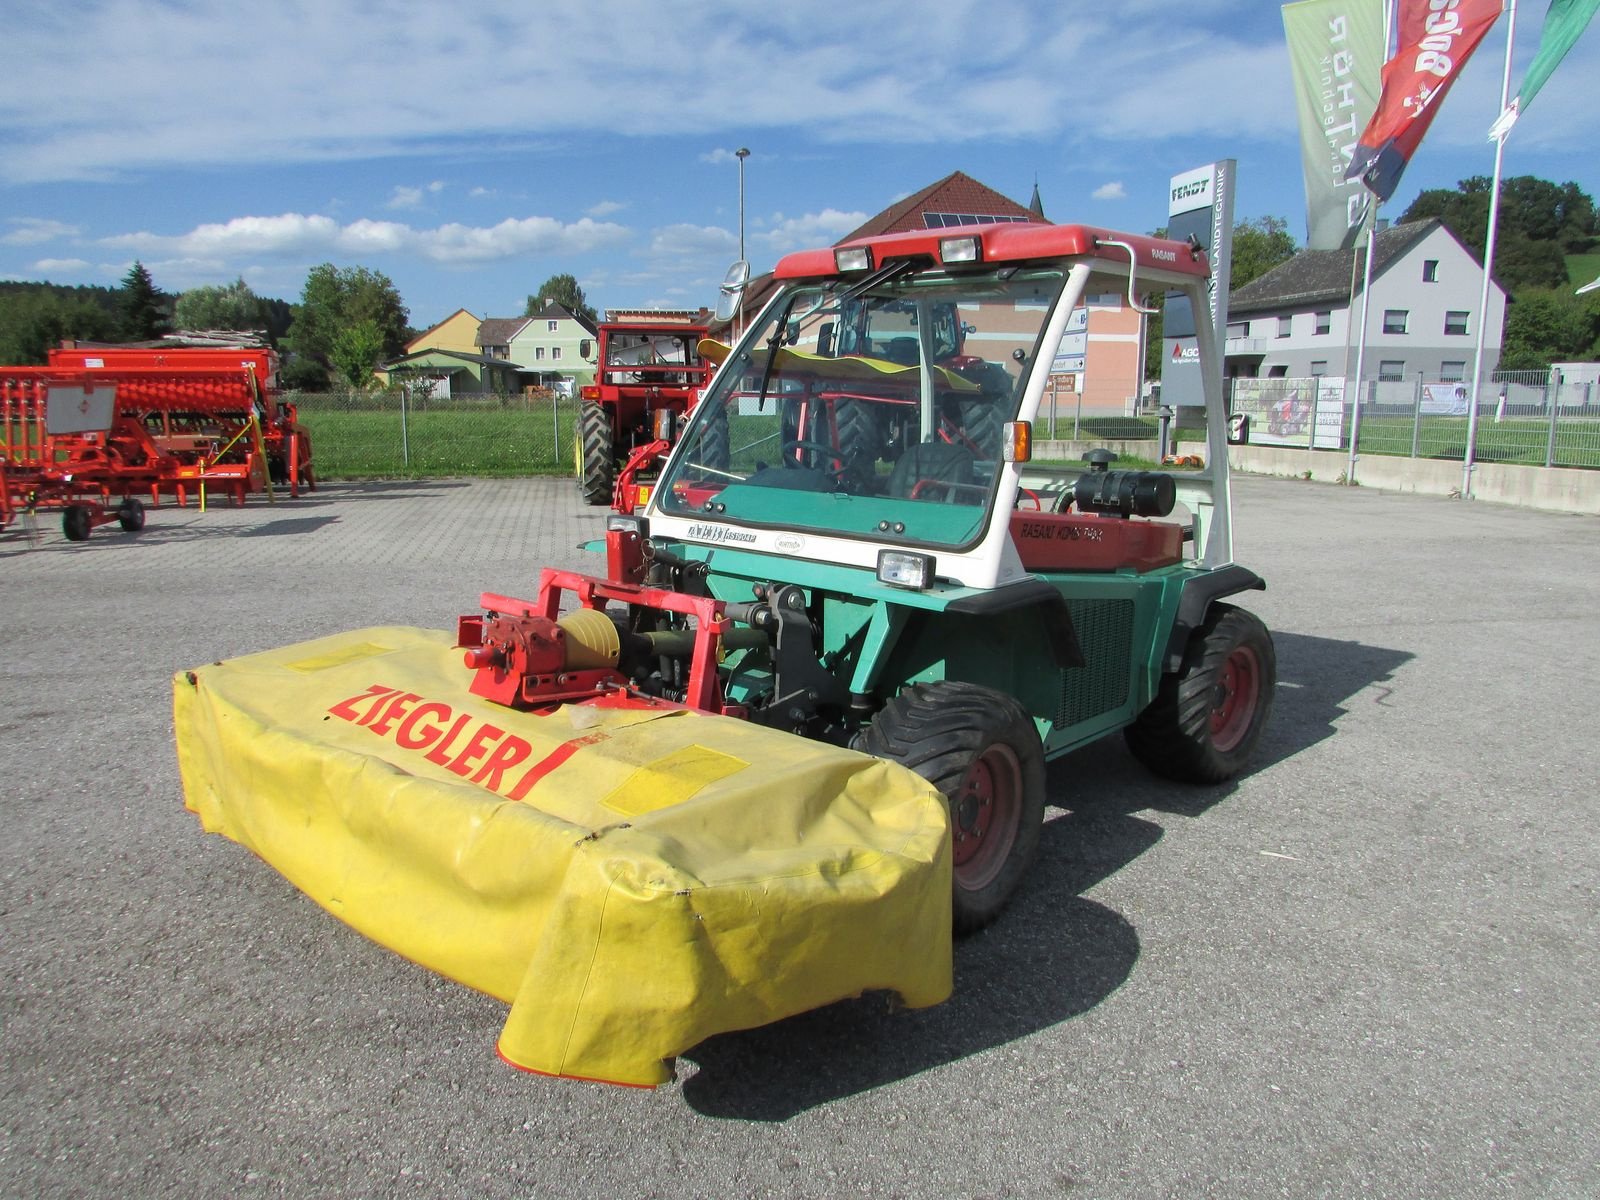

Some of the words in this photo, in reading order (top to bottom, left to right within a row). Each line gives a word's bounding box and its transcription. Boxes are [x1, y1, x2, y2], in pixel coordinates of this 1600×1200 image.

[1171, 178, 1210, 202] FENDT
[1212, 167, 1226, 267] LANDTECHNIK
[1181, 347, 1200, 358] AGC
[326, 684, 533, 793] ZIEGLER
